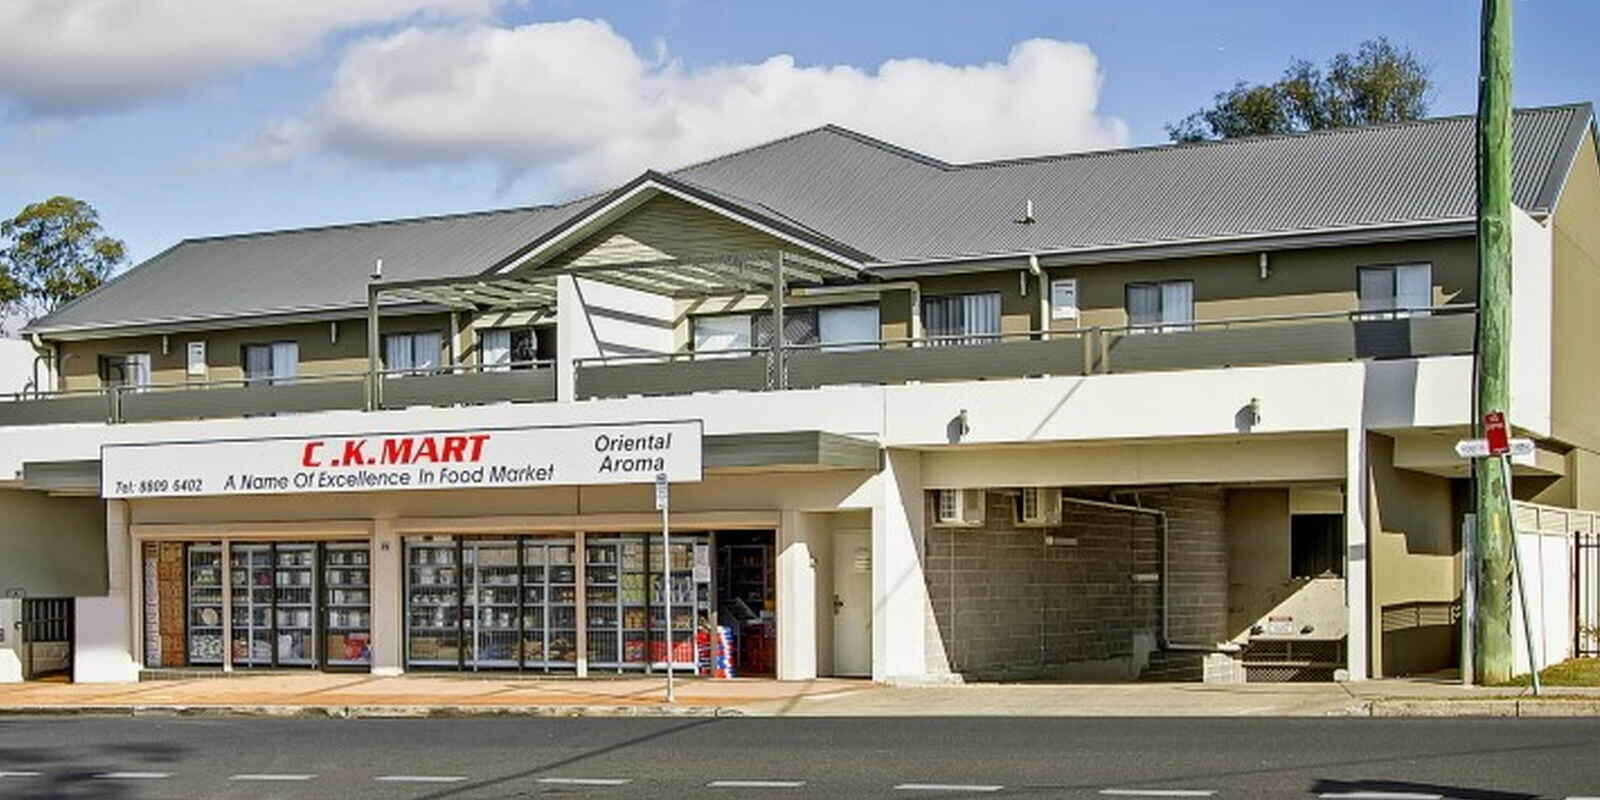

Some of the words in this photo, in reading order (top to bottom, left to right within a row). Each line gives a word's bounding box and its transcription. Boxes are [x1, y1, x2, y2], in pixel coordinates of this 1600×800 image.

[594, 433, 672, 452] Oriental
[600, 456, 665, 473] Aroma
[224, 475, 237, 490] A
[241, 475, 288, 490] Name
[293, 473, 315, 489] Of
[318, 470, 411, 488] Excellence
[419, 468, 434, 484] In
[439, 466, 484, 484] Food
[489, 464, 553, 482] Market
